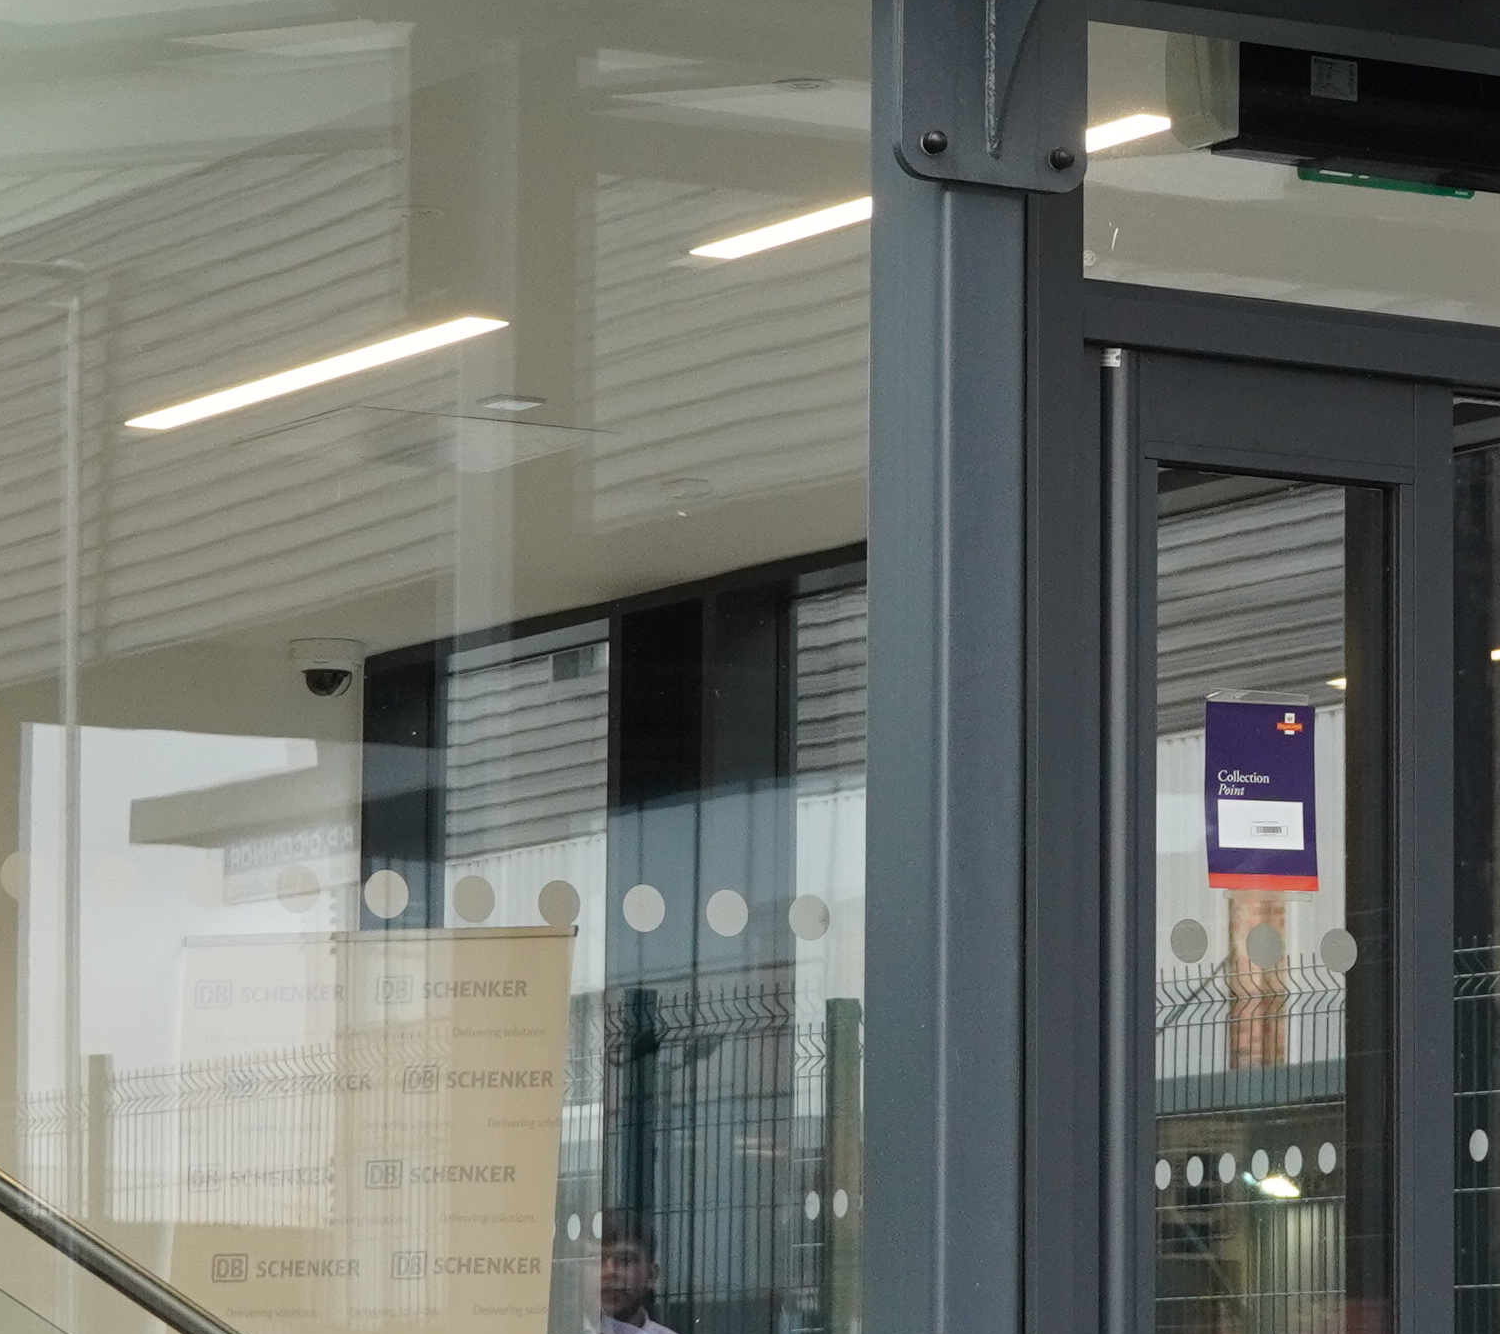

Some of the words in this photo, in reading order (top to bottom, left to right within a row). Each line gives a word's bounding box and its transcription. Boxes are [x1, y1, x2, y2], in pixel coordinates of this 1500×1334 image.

[1217, 769, 1270, 784] Collection
[1217, 783, 1246, 796] Point
[240, 983, 345, 1004] SCHENKER
[422, 979, 528, 999] SCHENKER
[452, 1026, 502, 1039] Delivering
[407, 1071, 436, 1090] DB
[446, 1069, 553, 1090] SCHENKER
[487, 1118, 536, 1130] Delivering
[368, 1165, 398, 1185] DB
[409, 1165, 516, 1184] SCHENKER
[215, 1257, 245, 1279] DB
[256, 1258, 360, 1279] SCHENKER
[433, 1256, 541, 1276] SCHENKER
[473, 1304, 522, 1317] Delivering
